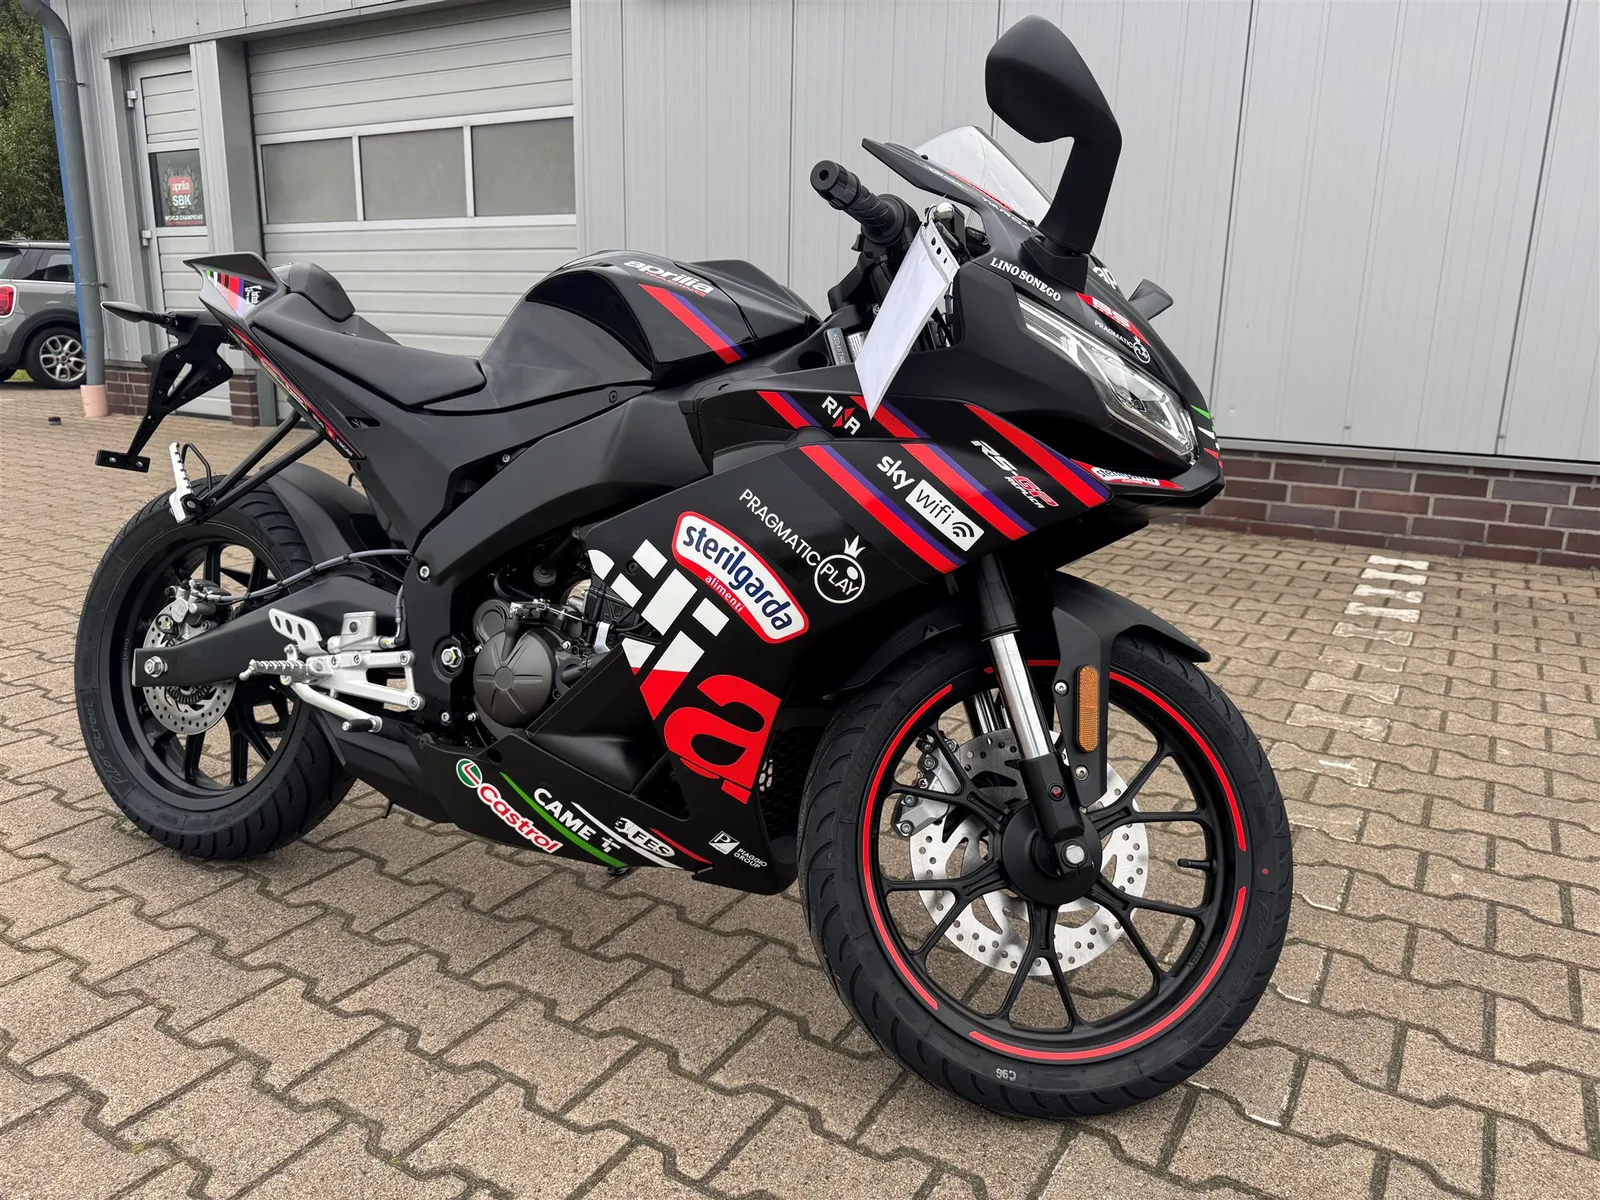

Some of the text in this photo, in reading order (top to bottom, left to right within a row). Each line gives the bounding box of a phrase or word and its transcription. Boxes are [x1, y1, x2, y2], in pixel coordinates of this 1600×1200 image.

[172, 195, 192, 206] SBK
[623, 260, 714, 295] aprilia
[989, 257, 1062, 302] LINO SONEGO
[1094, 319, 1134, 349] PRAGMATIC
[876, 455, 955, 525] sky wifi
[1003, 475, 1046, 509] REPLICA
[739, 488, 860, 596] PRAGMATIC PLAY
[682, 525, 793, 631] sterilgarda
[705, 574, 745, 613] alimenti
[477, 783, 563, 853] Castrol
[533, 787, 597, 841] CAME
[733, 852, 761, 868] GROUP
[737, 848, 768, 867] PIAGGIO
